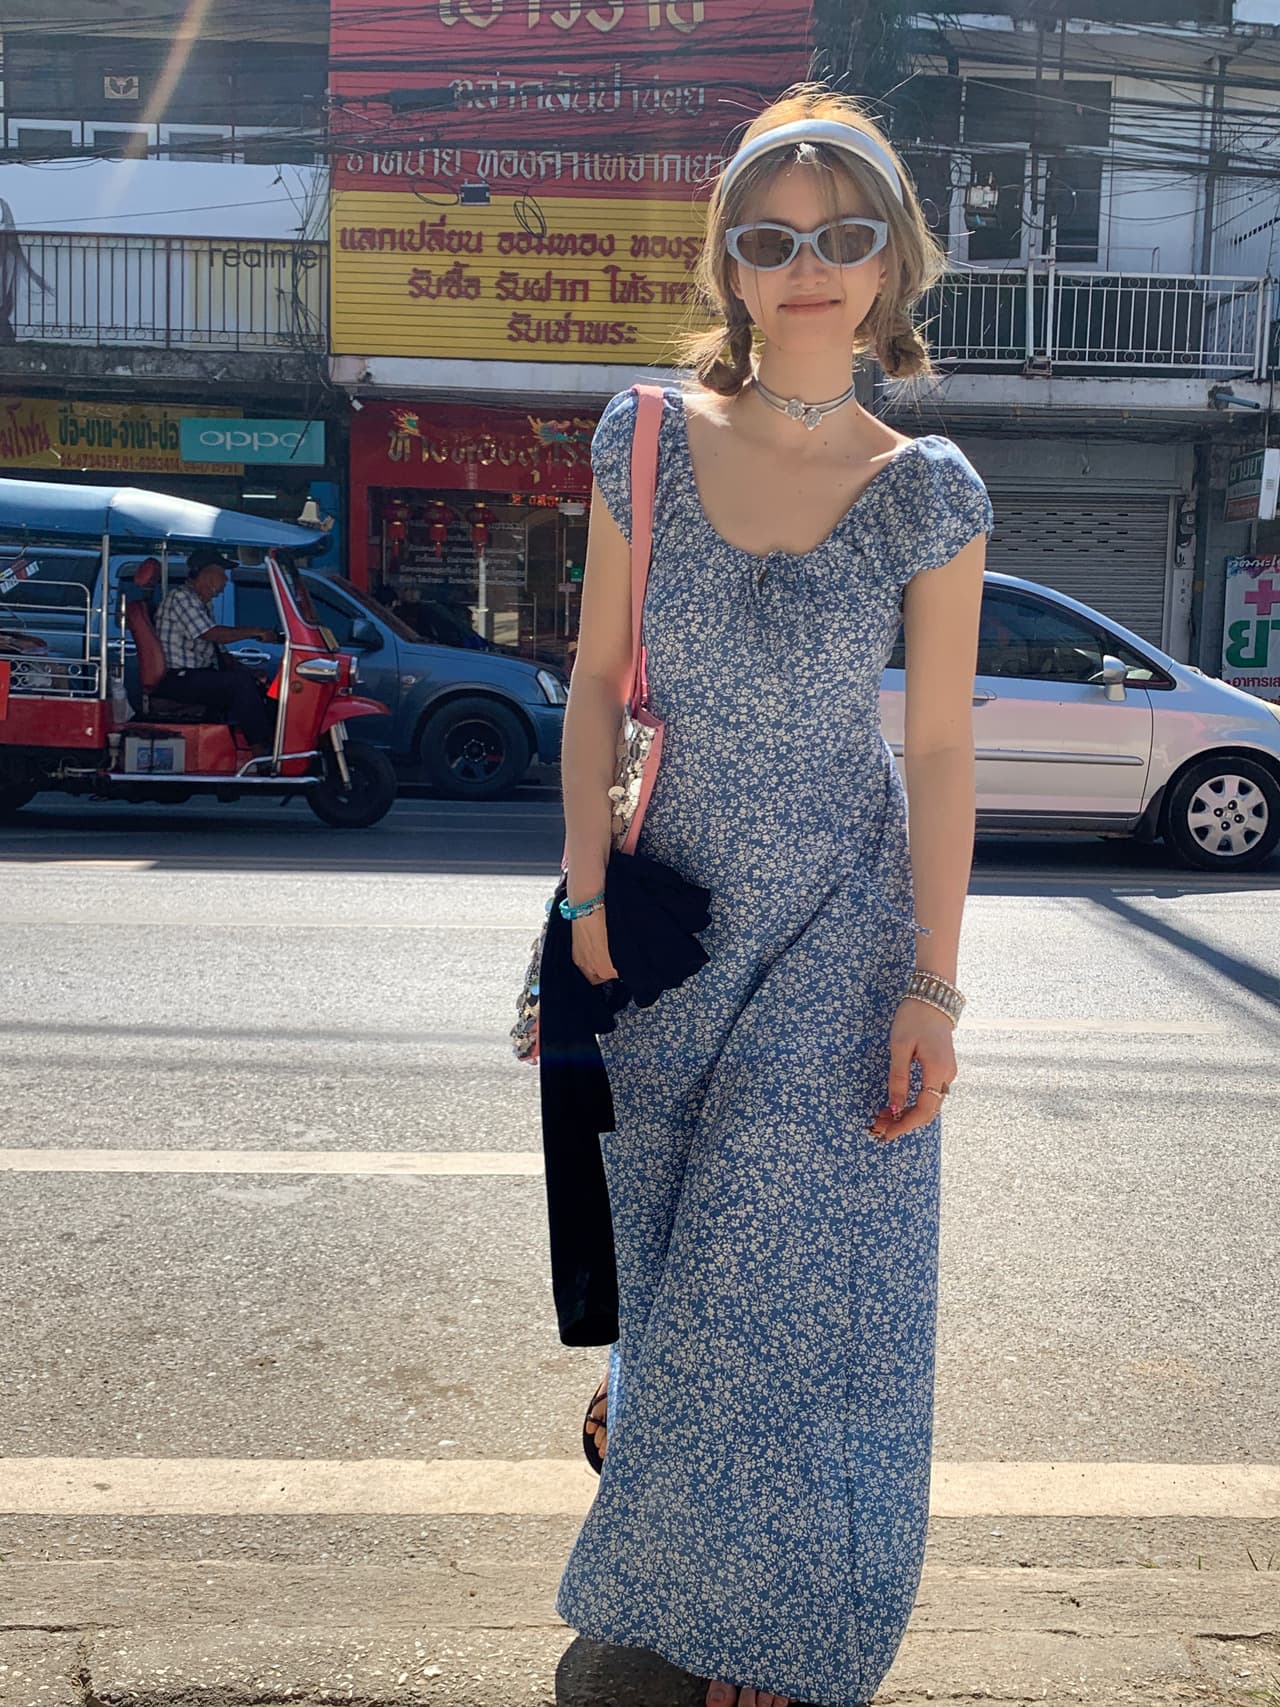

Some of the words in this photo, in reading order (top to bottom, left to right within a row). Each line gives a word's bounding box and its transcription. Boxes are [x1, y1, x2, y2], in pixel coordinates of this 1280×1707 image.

[208, 247, 318, 268] realme
[340, 213, 483, 254] แลกเปลี่ยน
[497, 231, 616, 257] ออมทอง
[630, 234, 707, 271] ทองรู
[408, 260, 482, 300] รับซื้อ
[495, 270, 590, 303] รับฝาก
[507, 311, 639, 345] รับเช่าพระ
[199, 430, 305, 452] oppo
